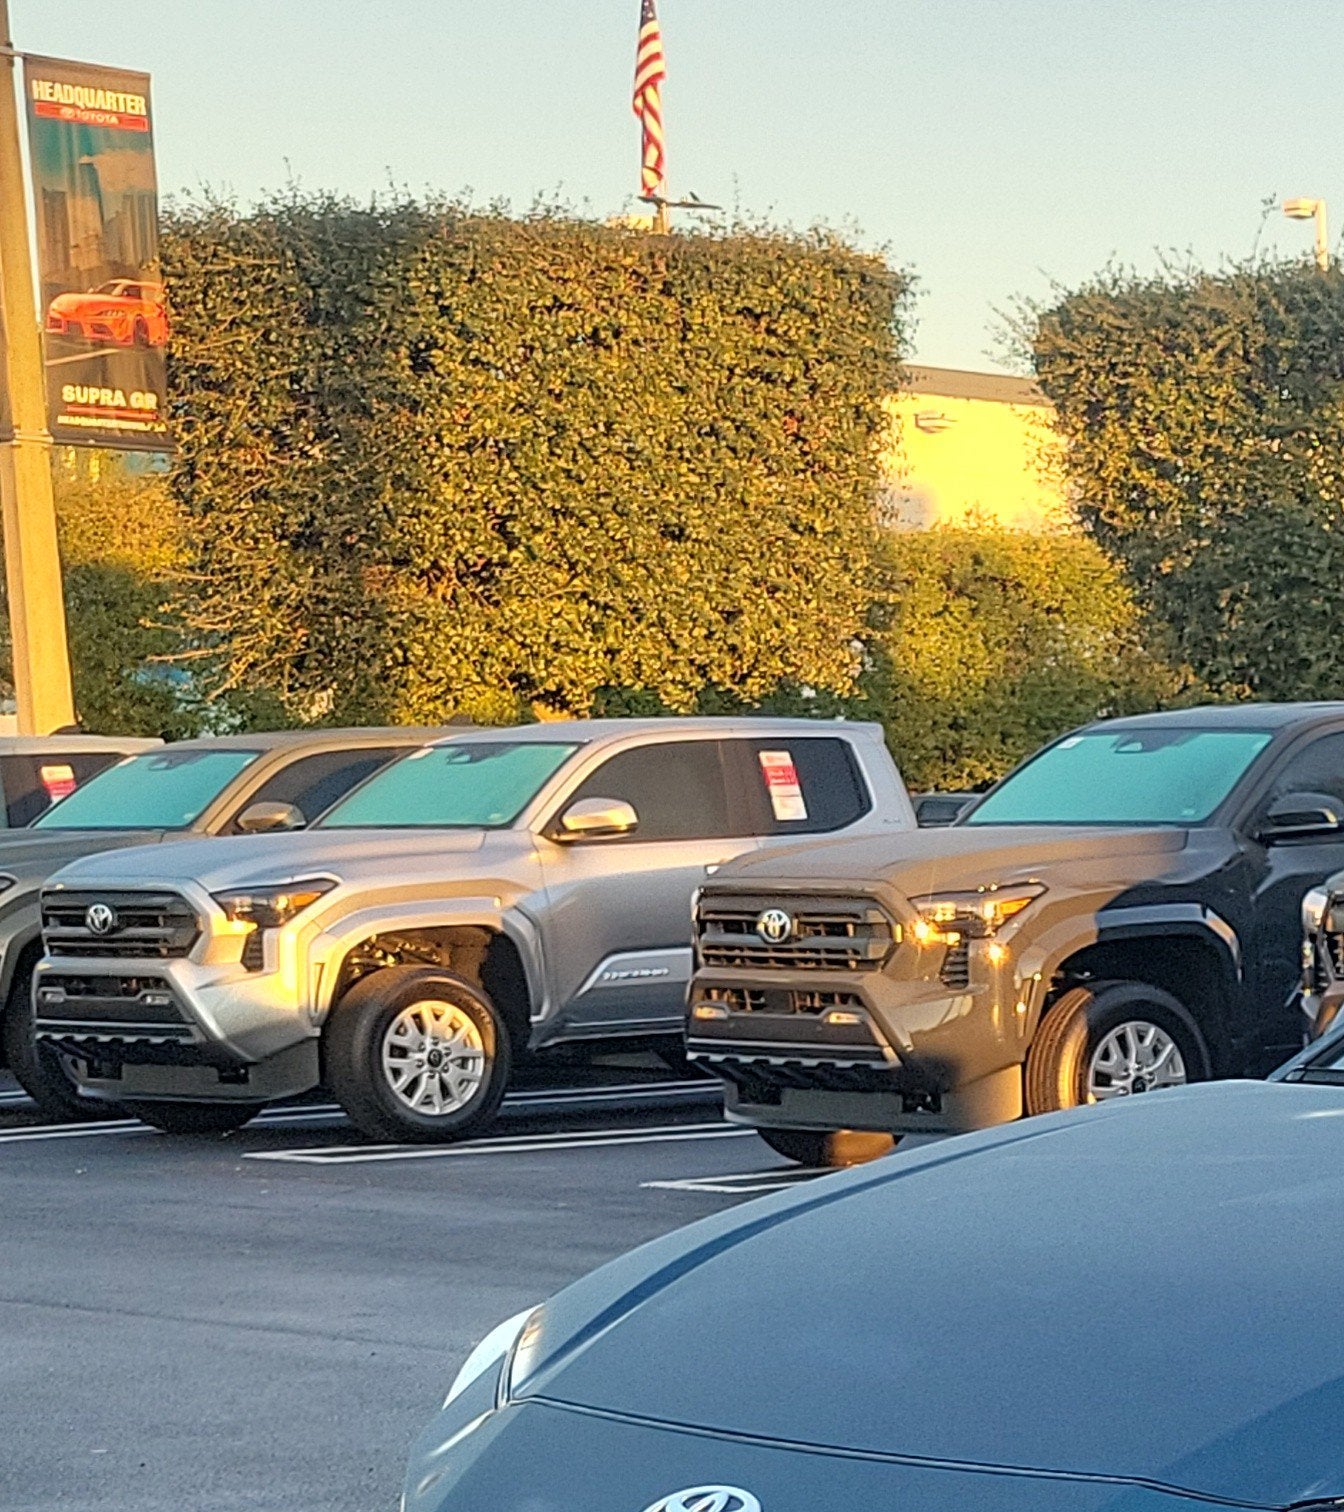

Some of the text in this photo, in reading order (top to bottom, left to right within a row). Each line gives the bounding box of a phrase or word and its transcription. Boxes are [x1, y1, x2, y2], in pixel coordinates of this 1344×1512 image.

[32, 79, 146, 115] HEADQUARTER
[74, 108, 119, 125] TOYOTA
[62, 384, 158, 410] SUPRA GR
